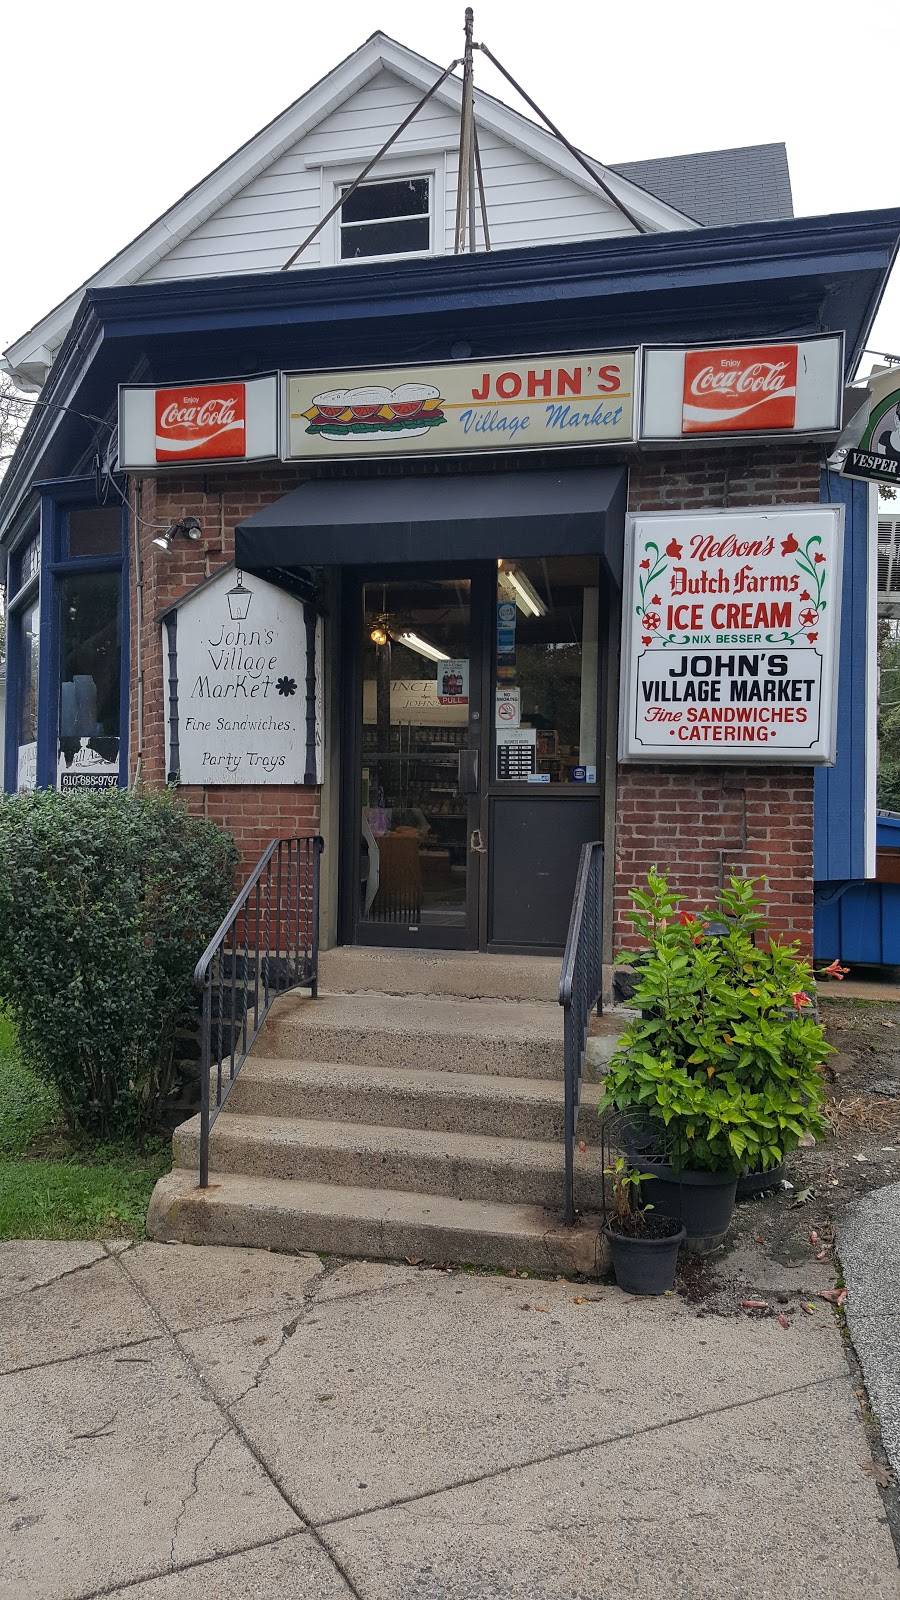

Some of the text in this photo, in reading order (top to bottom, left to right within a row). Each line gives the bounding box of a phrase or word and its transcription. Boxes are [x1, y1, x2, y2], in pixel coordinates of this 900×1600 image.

[721, 359, 741, 368] Enjoy
[471, 365, 621, 400] JOHN'S
[690, 360, 791, 395] Coca-Cola
[183, 396, 200, 405] Enjoy
[161, 398, 239, 429] Coca-Cola
[460, 402, 623, 439] Village Market
[852, 452, 898, 473] VESPER
[690, 533, 775, 561] Nelson's
[670, 564, 800, 597] Dutch Farms
[666, 602, 792, 630] ICE CREAM
[208, 622, 274, 646] John's
[692, 634, 762, 645] NIX BESSER
[208, 647, 278, 679] Village
[669, 653, 789, 677] JOHN'S
[642, 680, 815, 702] VILLAGE MARKET
[185, 717, 211, 731] Fine
[644, 706, 808, 723] Fine SANDWICHES
[202, 752, 286, 772] Party Trays
